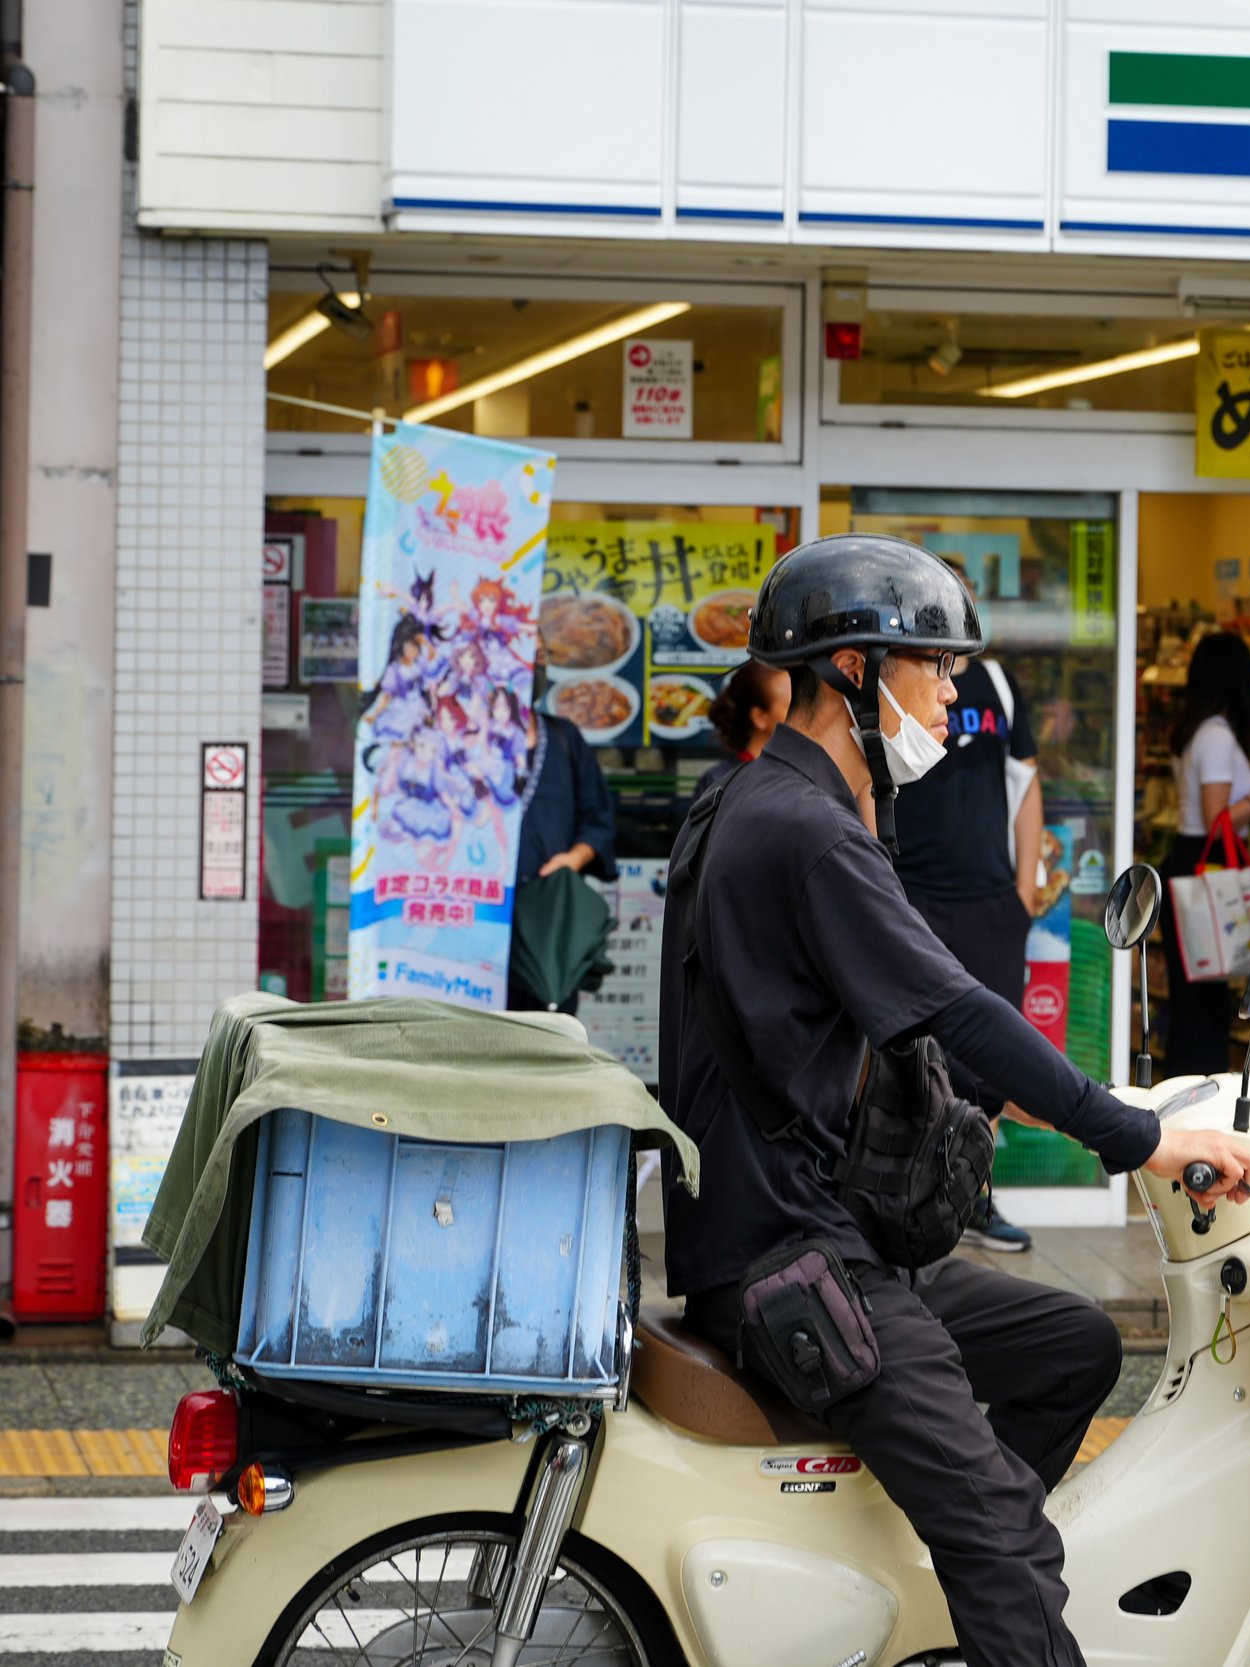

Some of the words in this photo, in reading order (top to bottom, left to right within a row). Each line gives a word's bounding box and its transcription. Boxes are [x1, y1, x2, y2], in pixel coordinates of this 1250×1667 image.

[394, 962, 493, 1003] FamilyMart
[46, 1117, 74, 1228] 消火器
